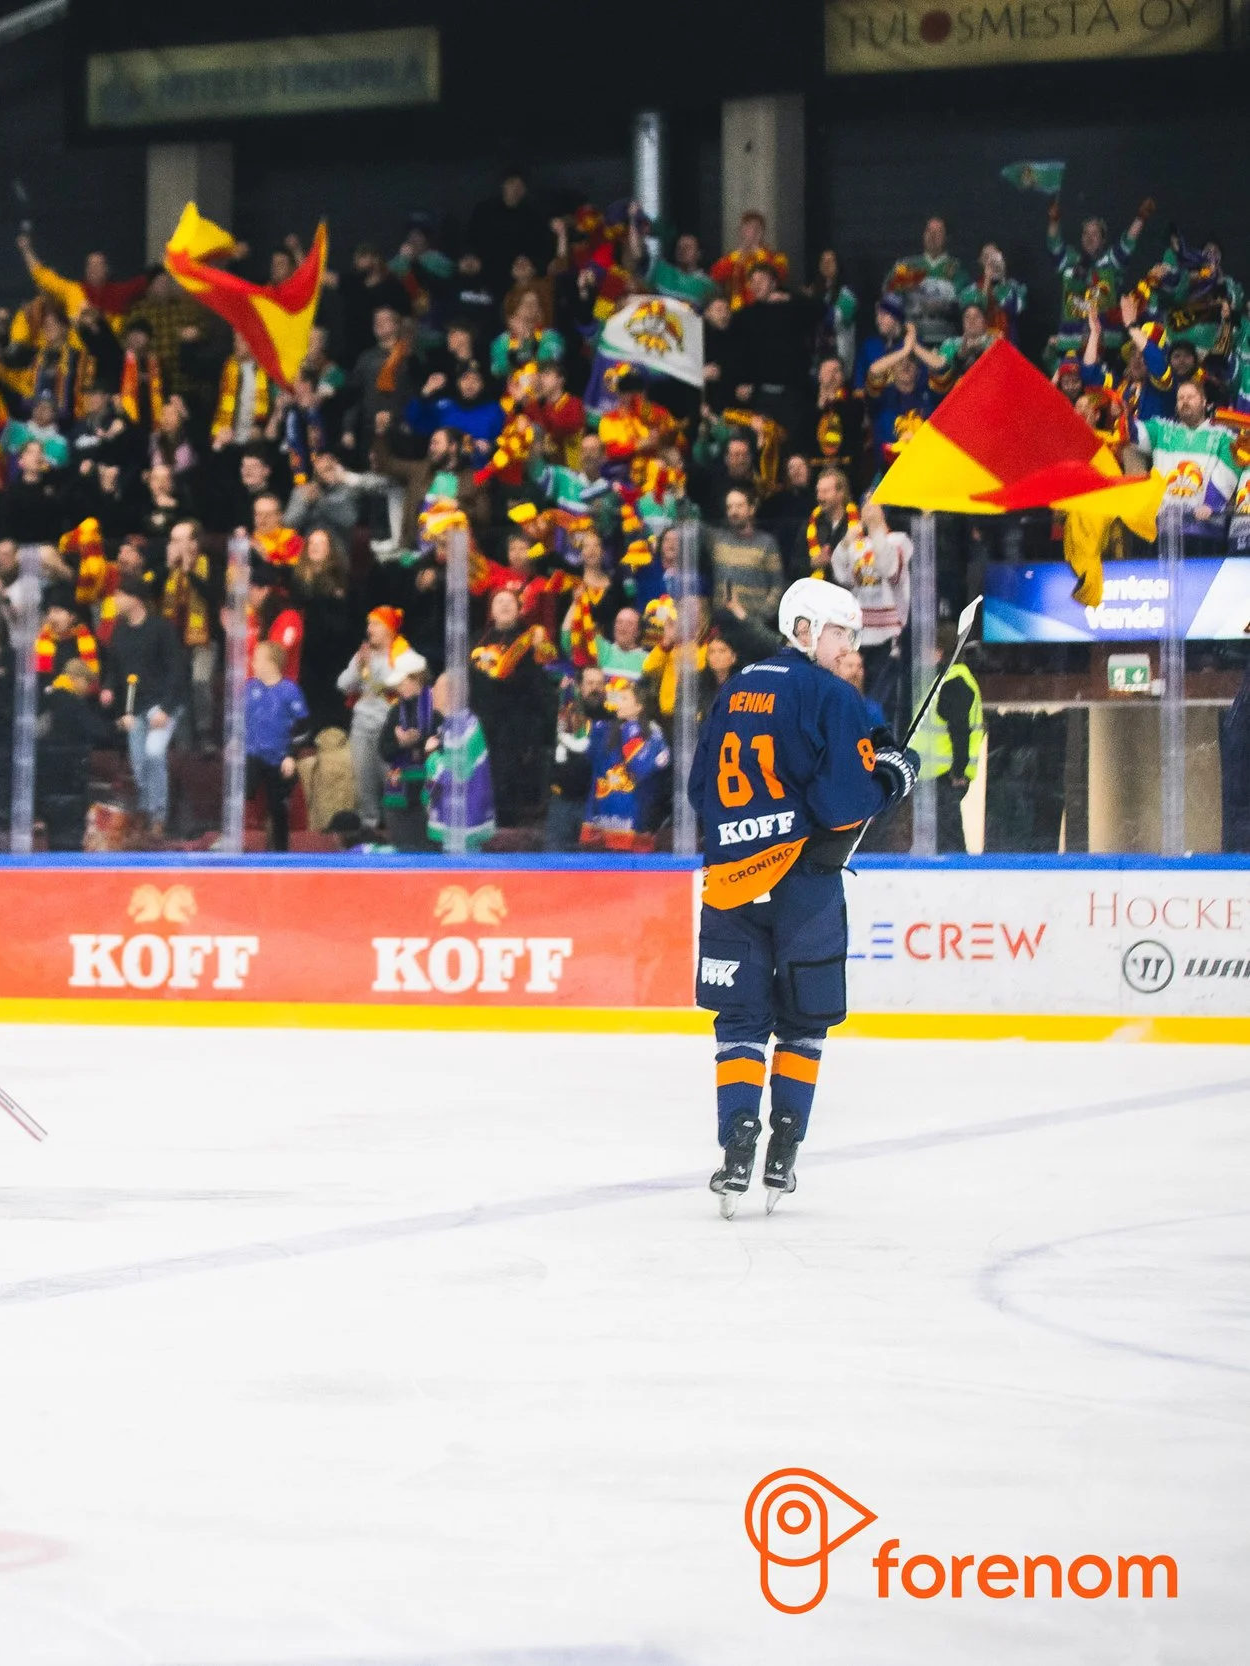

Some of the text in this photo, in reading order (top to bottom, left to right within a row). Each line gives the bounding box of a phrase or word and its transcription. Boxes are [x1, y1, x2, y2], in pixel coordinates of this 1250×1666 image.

[717, 731, 786, 808] 81
[856, 738, 877, 772] 8
[718, 811, 796, 845] KOFF
[728, 847, 795, 884] CRONIMO
[1088, 890, 1250, 930] HOCKE
[68, 933, 259, 989] KOFF
[904, 922, 1047, 961] CREW
[371, 936, 573, 992] KOFF
